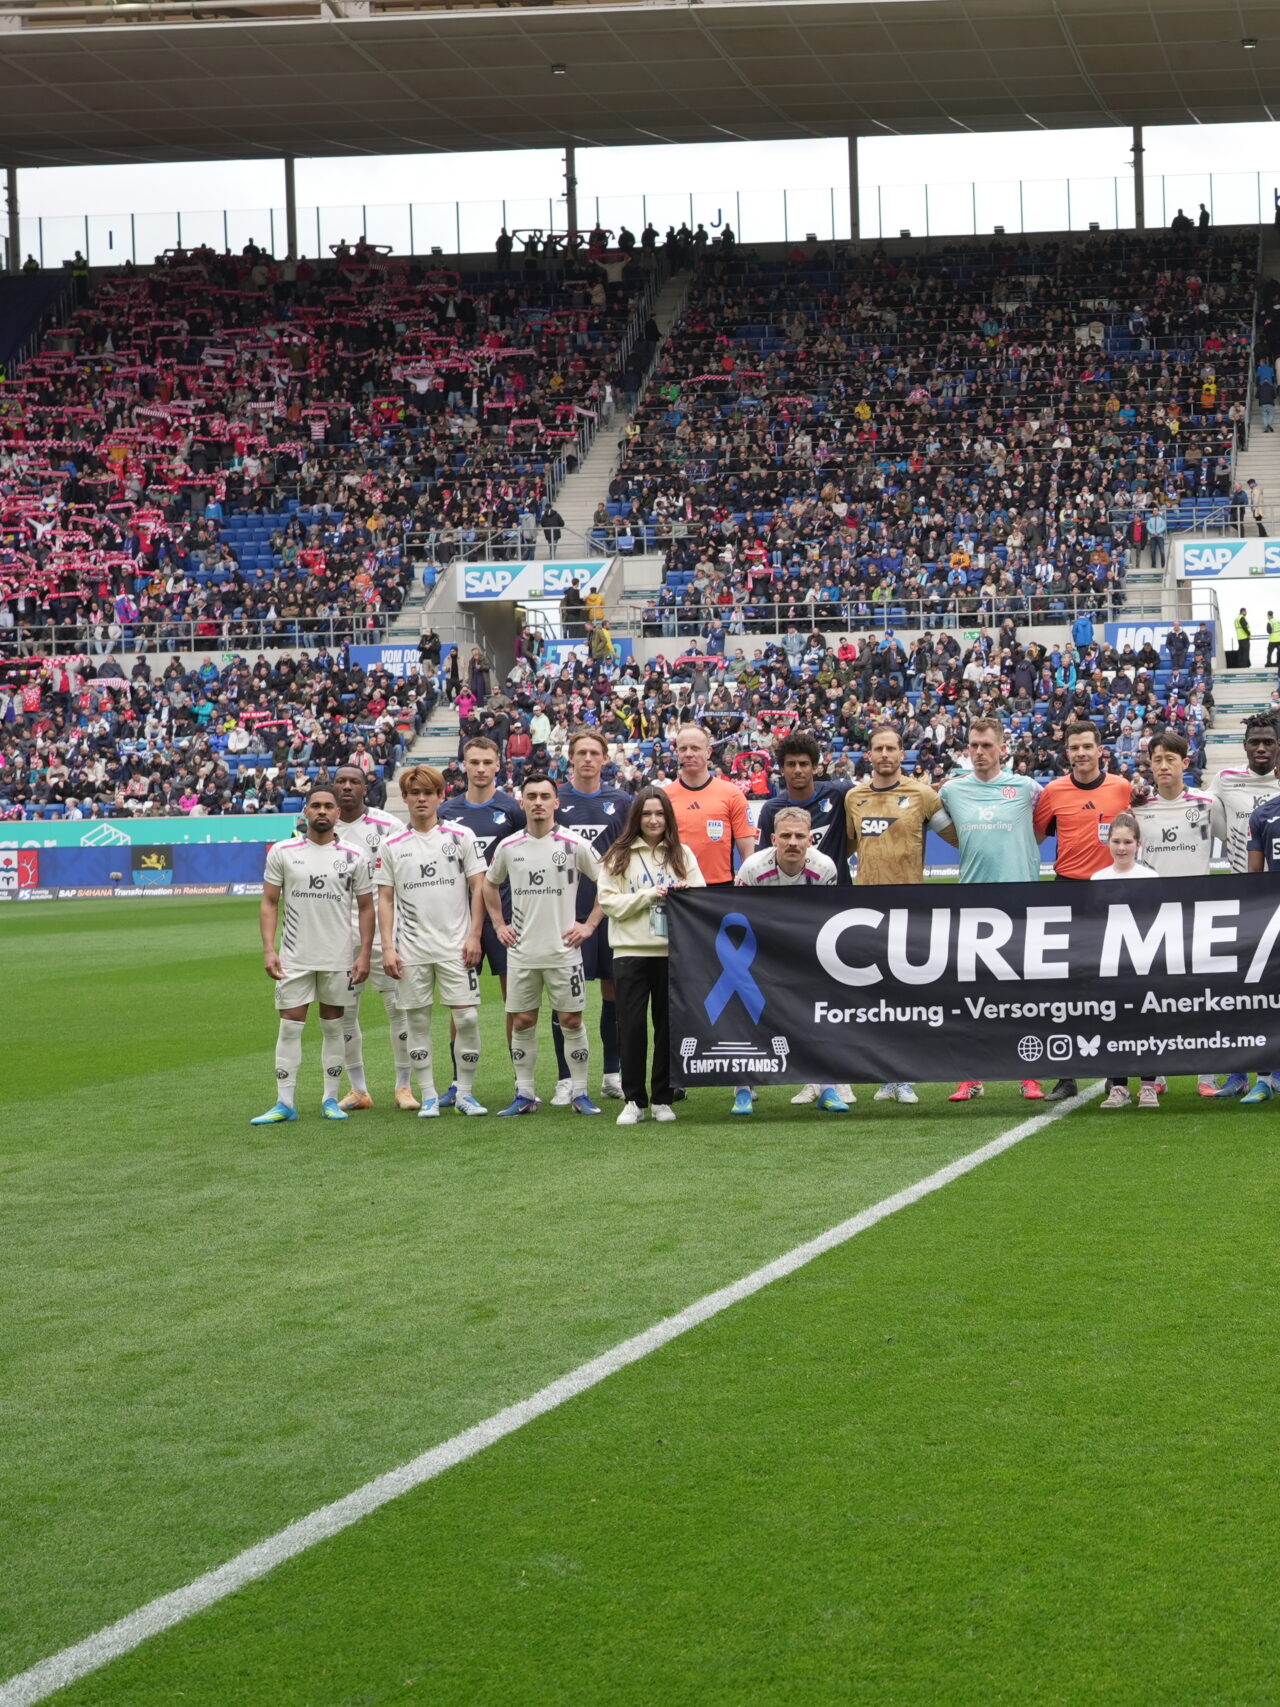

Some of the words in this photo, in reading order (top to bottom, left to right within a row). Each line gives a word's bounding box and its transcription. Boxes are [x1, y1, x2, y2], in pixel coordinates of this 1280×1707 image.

[710, 208, 722, 228] J
[1184, 548, 1232, 571] SAP
[465, 571, 512, 594] SAP
[544, 568, 591, 592] SAP
[381, 650, 402, 662] VOM
[861, 818, 889, 834] SAP
[1146, 843, 1197, 854] Kömmerling
[59, 889, 76, 898] SAP
[114, 886, 172, 897] Transformation
[174, 887, 182, 895] in
[183, 886, 227, 895] Rekordzeit!
[403, 877, 455, 890] Kömmerling
[513, 886, 564, 896] Kömmerling
[291, 890, 342, 901] Kömmerling
[815, 905, 1072, 986] CURE
[467, 969, 478, 991] 6
[814, 999, 943, 1027] Forschung
[965, 996, 1116, 1024] Versorgung
[1106, 1030, 1267, 1056] emptystands.me
[690, 1059, 729, 1074] EMPTY
[732, 1058, 779, 1073] STANDS
